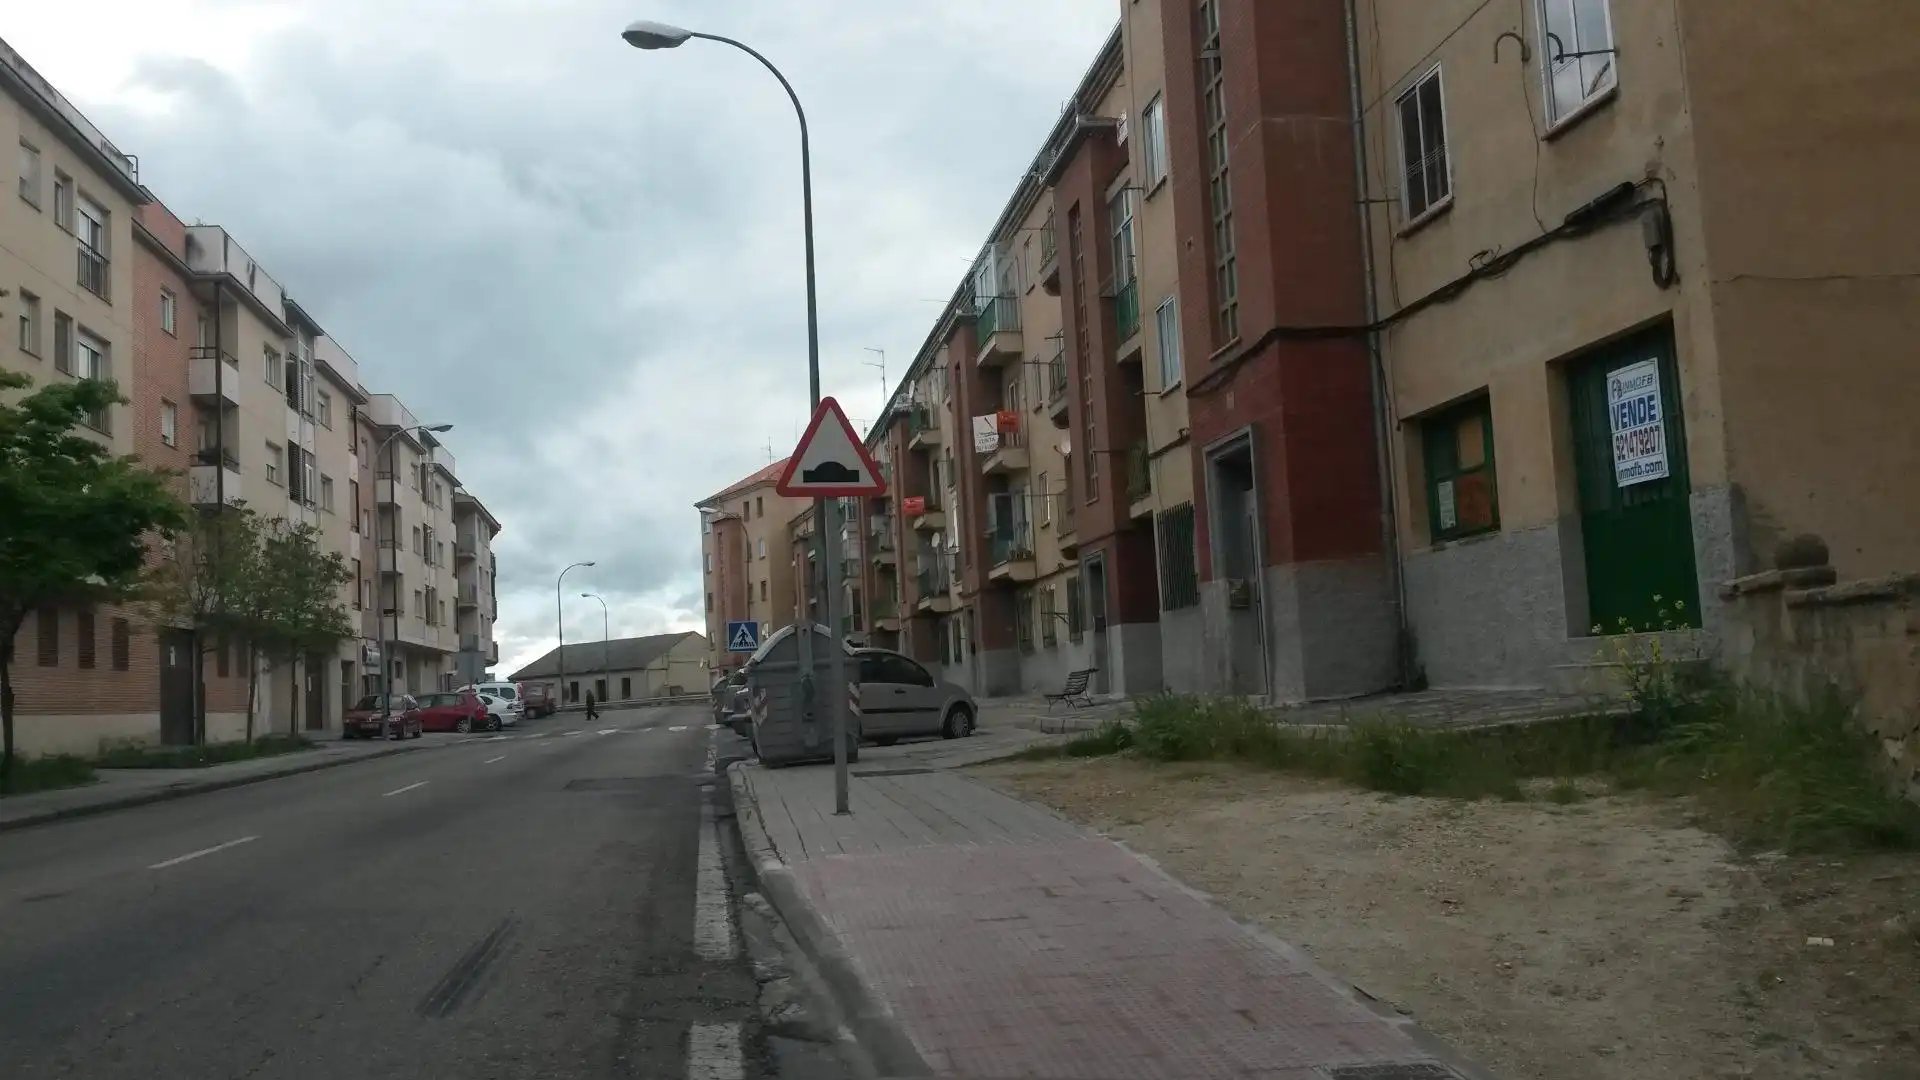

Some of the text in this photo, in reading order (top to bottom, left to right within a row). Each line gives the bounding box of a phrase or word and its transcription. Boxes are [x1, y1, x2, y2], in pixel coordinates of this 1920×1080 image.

[1612, 394, 1657, 431] VENDE
[1615, 425, 1660, 461] 921479207
[1618, 460, 1663, 480] inmofb.com
